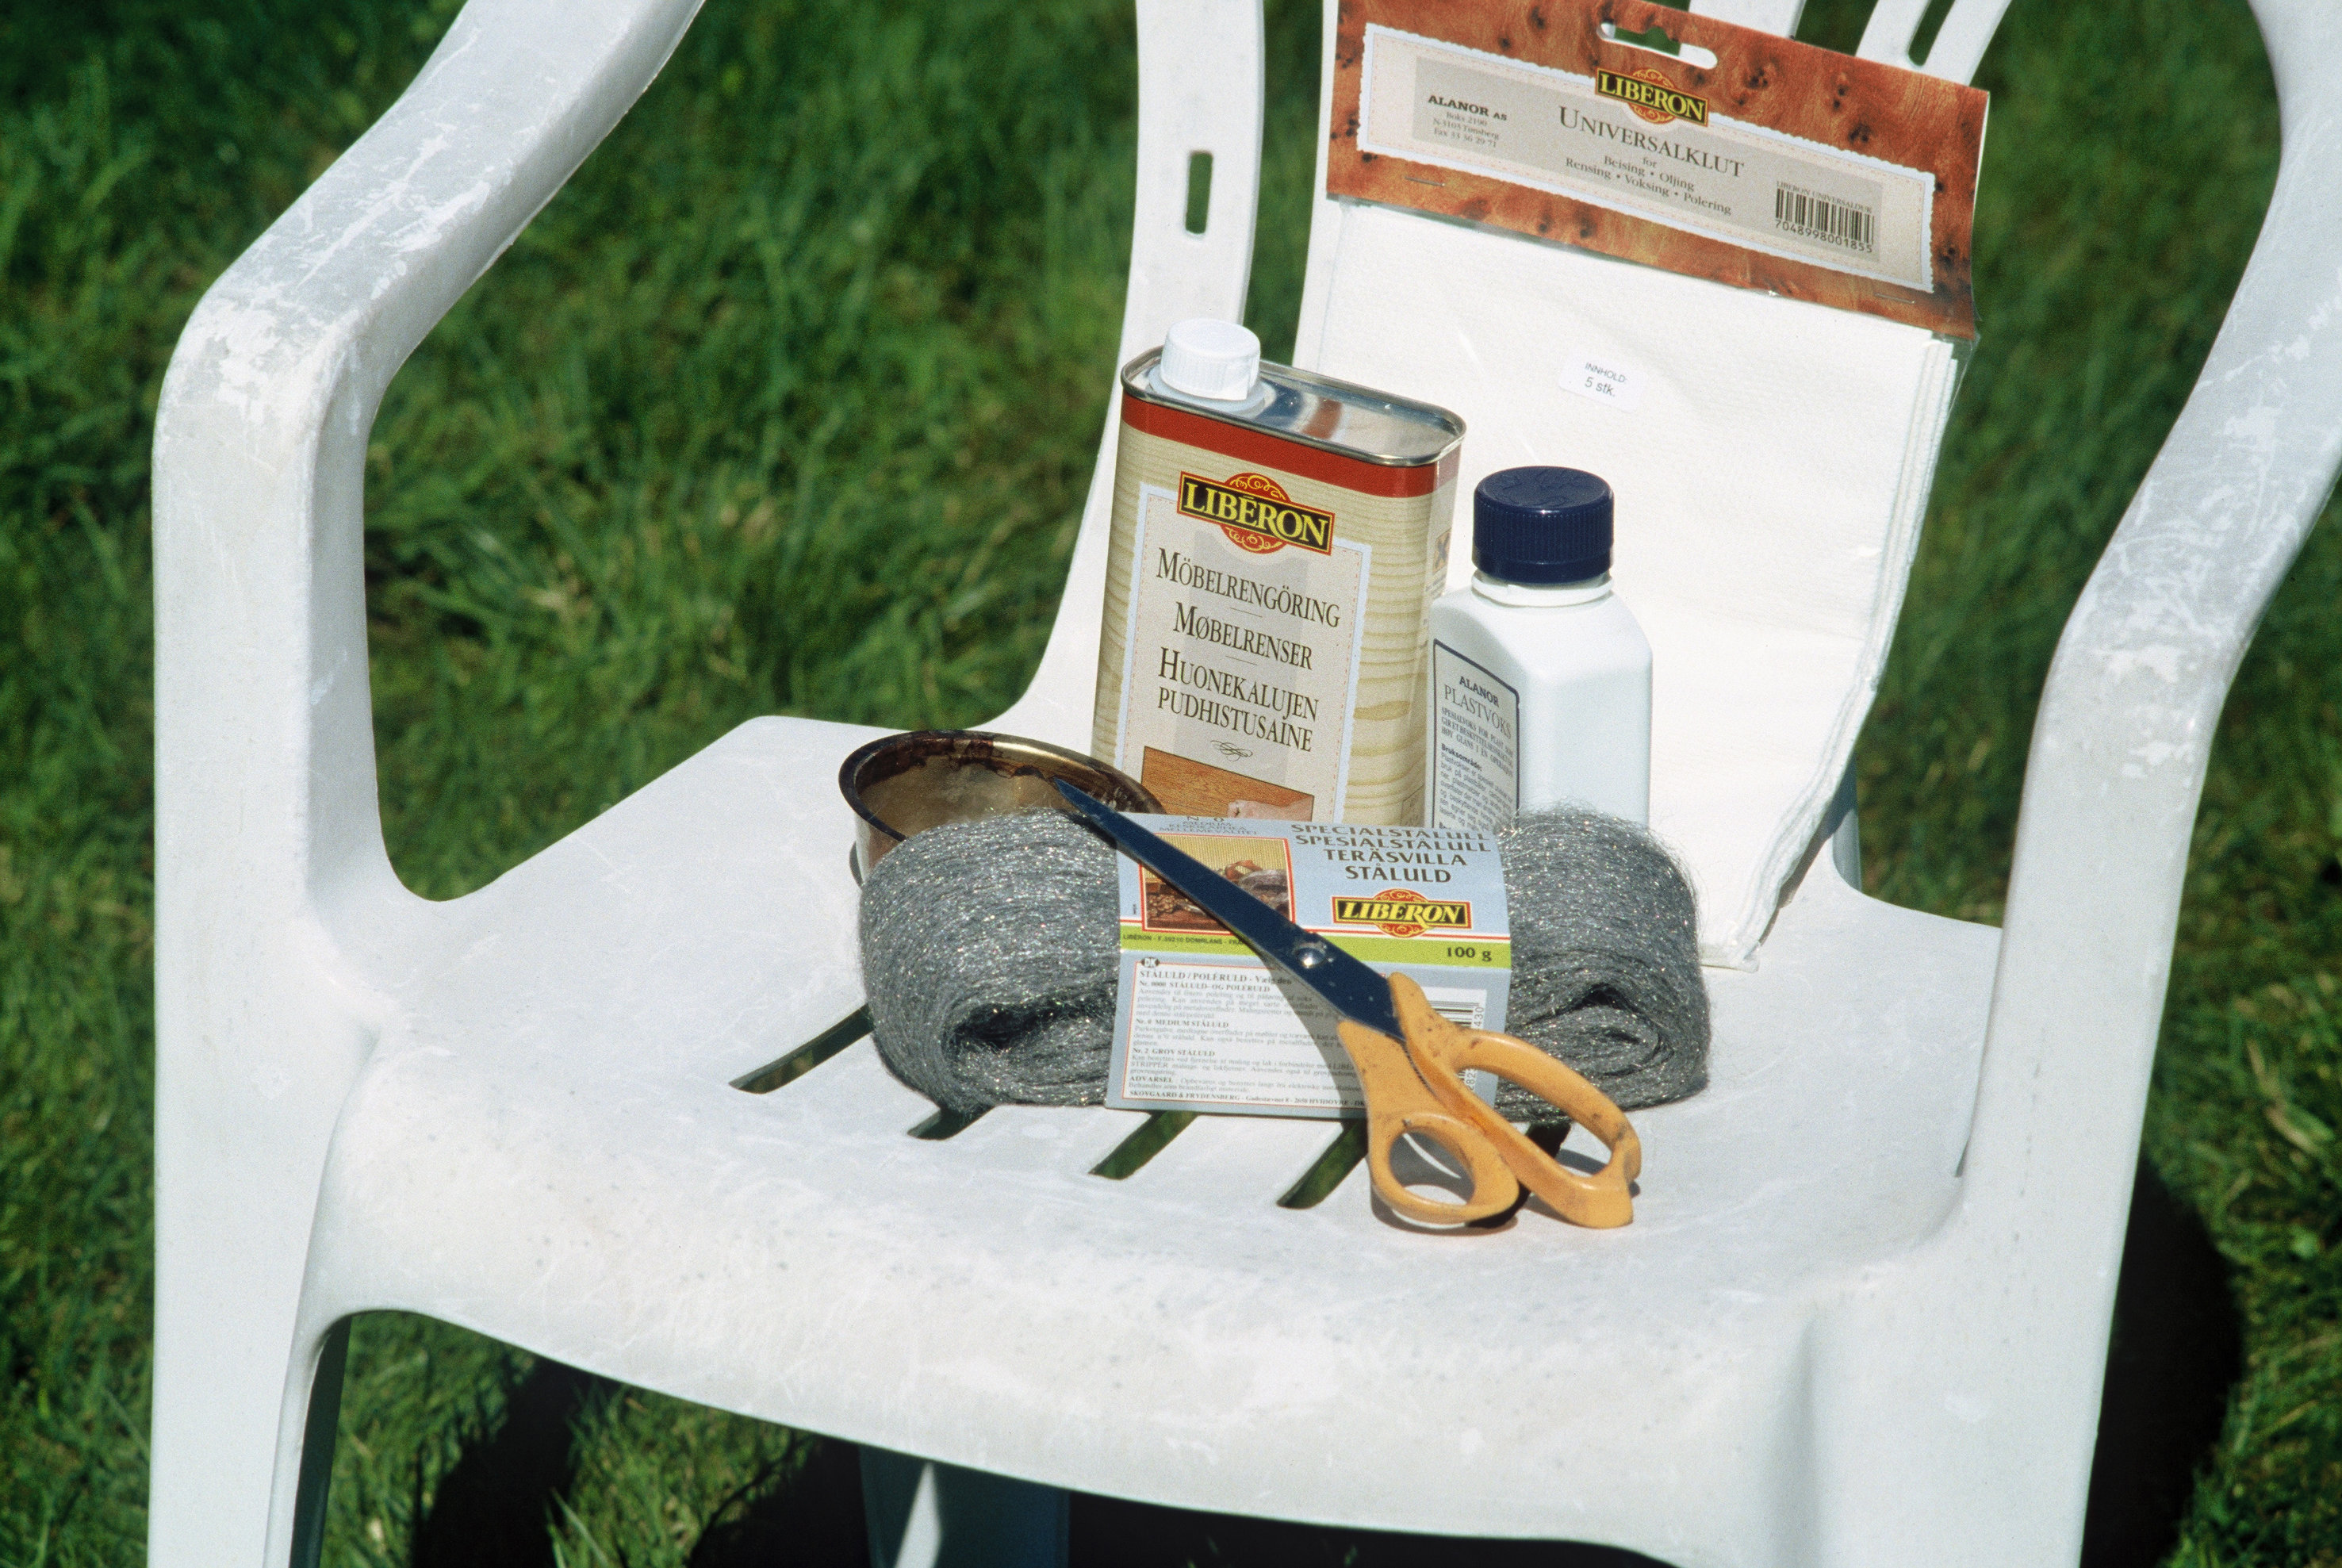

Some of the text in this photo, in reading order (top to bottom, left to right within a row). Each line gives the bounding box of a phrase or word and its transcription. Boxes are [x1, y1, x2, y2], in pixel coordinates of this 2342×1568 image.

[1428, 95, 1489, 117] ALANOR
[1559, 105, 1745, 177] UNIVERSALKLUT
[1604, 155, 1696, 193] Beising Oljing
[1643, 157, 1657, 168] for
[1566, 157, 1732, 216] Rensing Voksing Polering
[1585, 376, 1616, 397] 5 stk.
[1156, 547, 1340, 628] MÖBELRENGÖRING
[1173, 601, 1313, 671] MØBELRENSER
[1158, 646, 1320, 722] HUONEKALUJEN
[1459, 676, 1500, 707] ALANOR
[1157, 686, 1313, 753] PUDHISTUSAINE
[1444, 684, 1512, 739] PLASTVOKS
[1323, 849, 1467, 866] TERÄSVILLA
[1345, 863, 1452, 883] STÅLULD
[1144, 958, 1158, 967] DK
[1447, 947, 1493, 962] 100 g
[1140, 969, 1186, 979] STÅLULD
